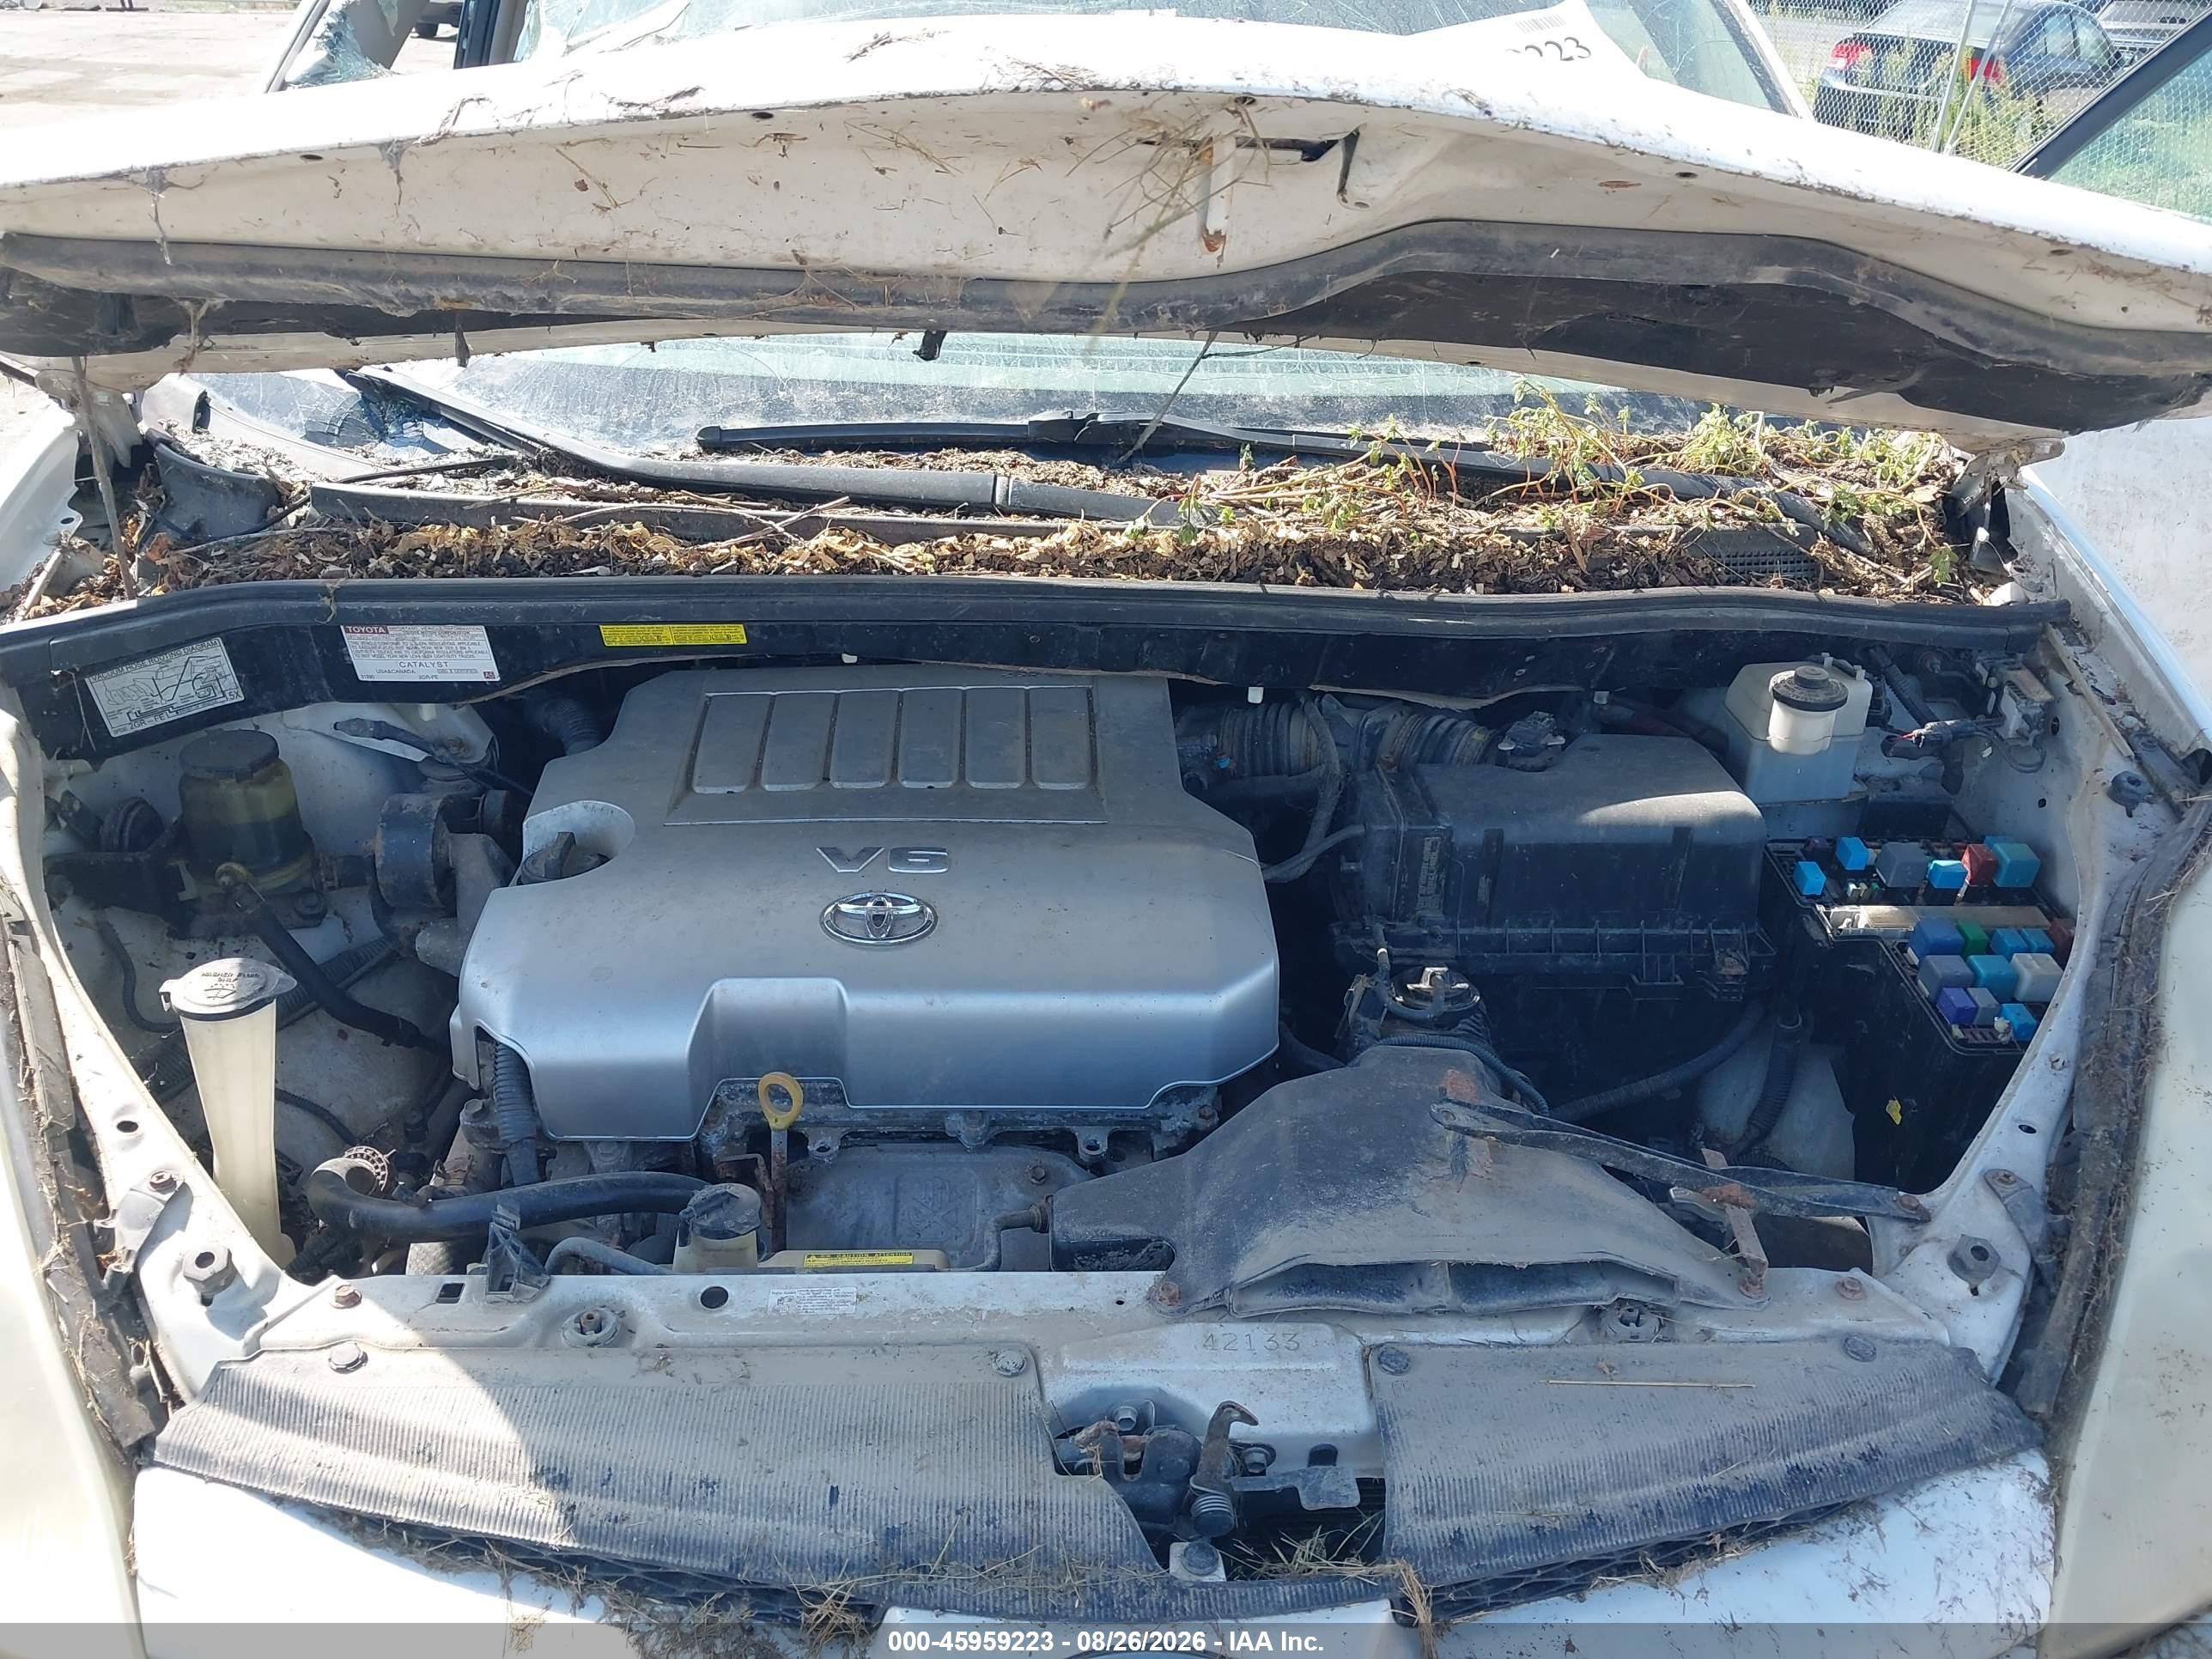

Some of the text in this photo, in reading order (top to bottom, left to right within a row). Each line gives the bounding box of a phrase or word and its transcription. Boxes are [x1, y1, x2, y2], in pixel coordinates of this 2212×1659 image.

[92, 640, 217, 681] VACUUM HOSE ROUTING DIAGRAM
[228, 690, 242, 701] 5X
[129, 718, 146, 730] 2GR
[155, 711, 166, 721] FE
[817, 847, 949, 873] V6
[1202, 1332, 1301, 1352] 42133
